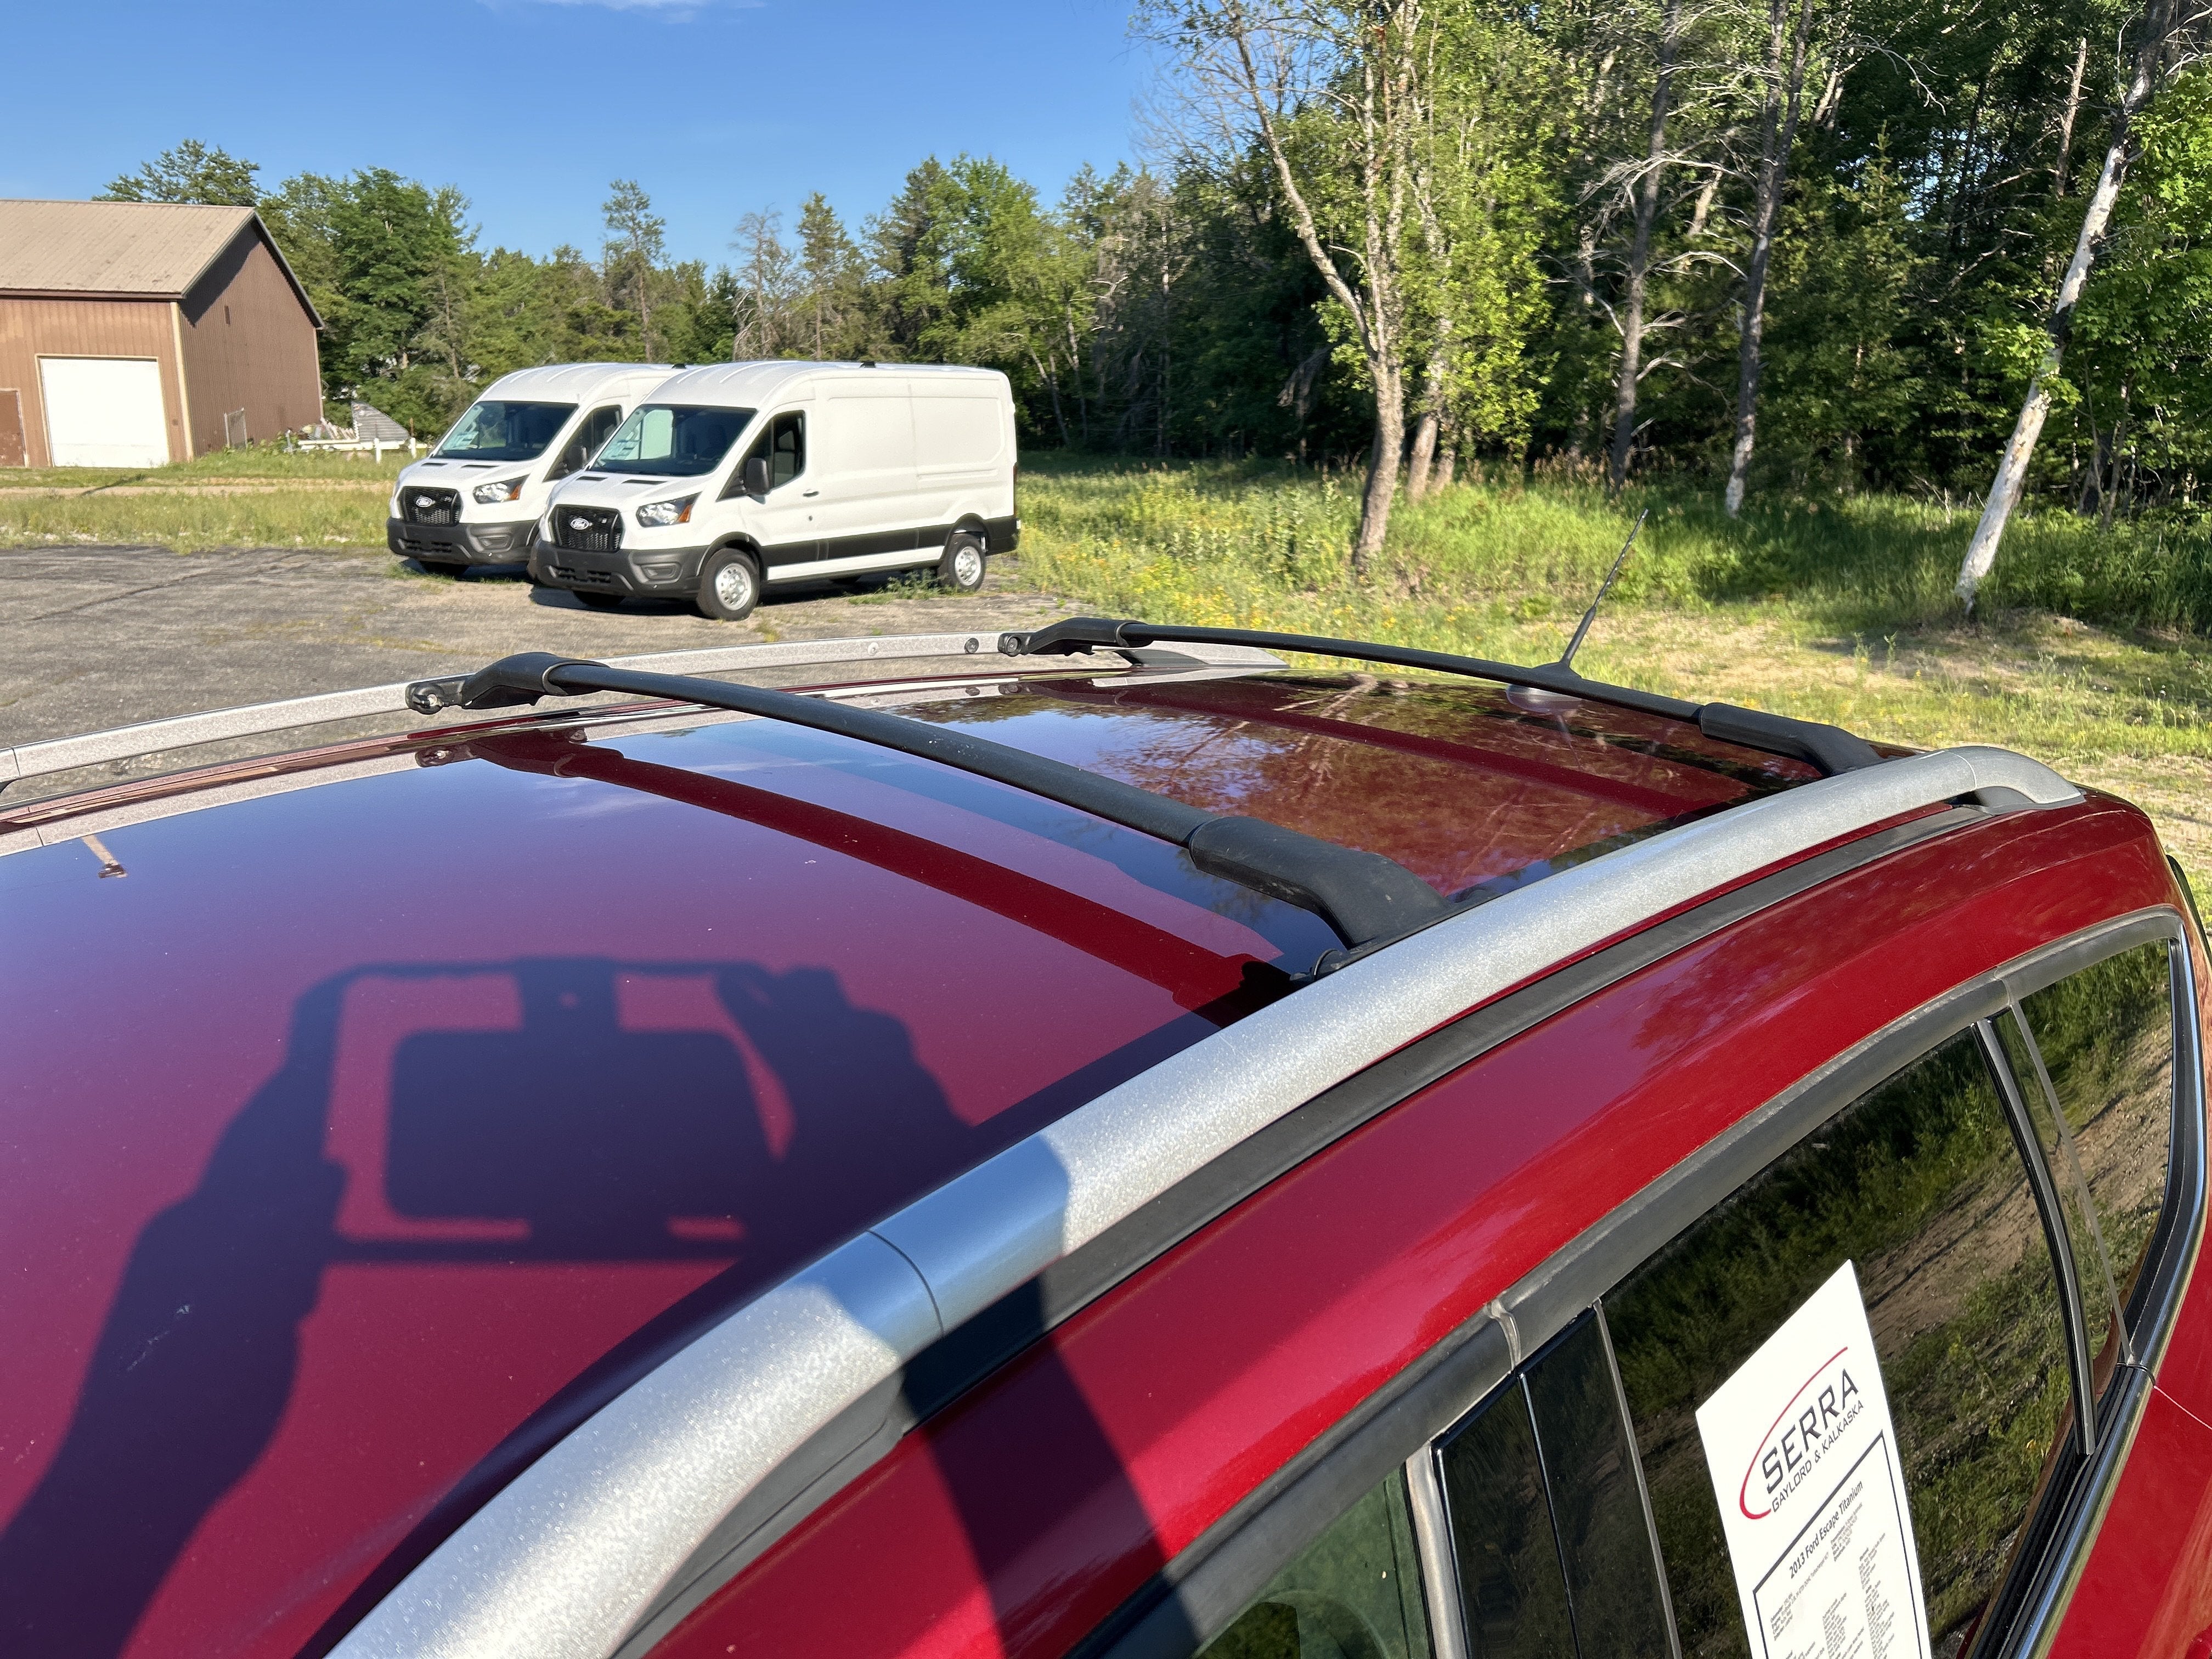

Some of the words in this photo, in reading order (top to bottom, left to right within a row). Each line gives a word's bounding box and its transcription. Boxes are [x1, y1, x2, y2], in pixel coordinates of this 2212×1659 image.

[1762, 1368, 1858, 1494] SERRA
[1772, 1459, 1812, 1513] GAYLORD
[1814, 1450, 1821, 1463] &
[1821, 1400, 1864, 1454] KALKASKA
[1790, 1552, 1805, 1579] 2013
[1805, 1533, 1819, 1559] Ford
[1819, 1511, 1839, 1541] Escape
[1839, 1481, 1863, 1514] Titanium
